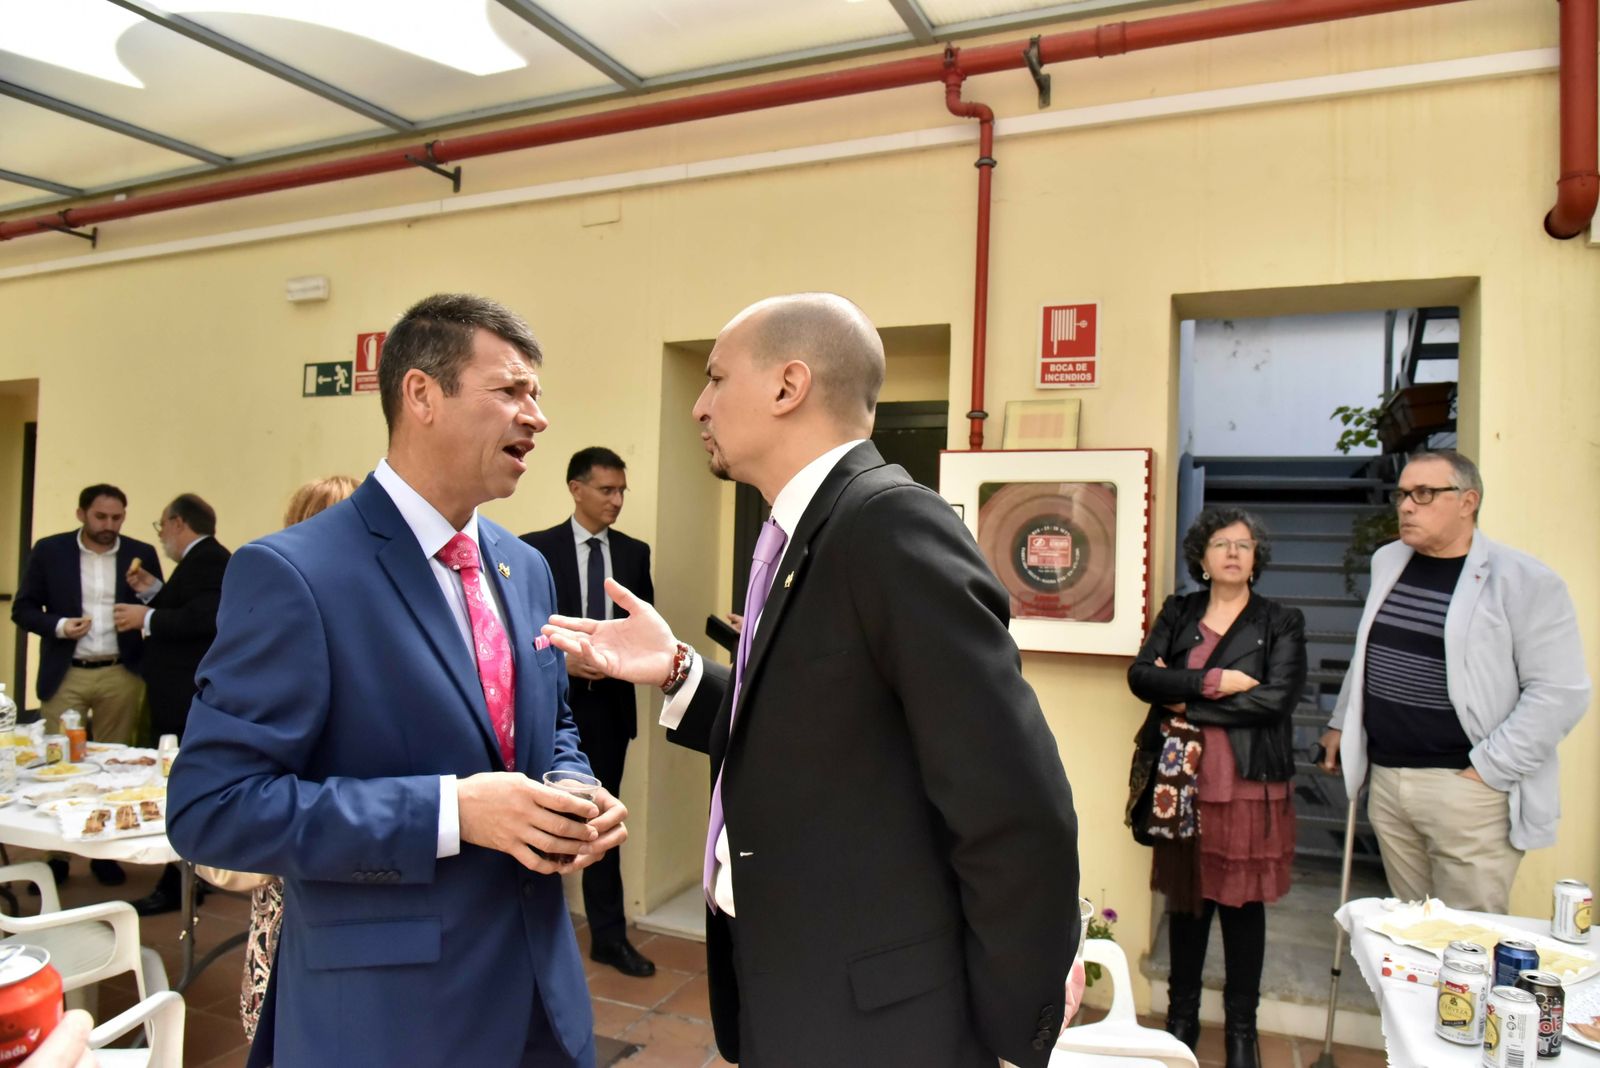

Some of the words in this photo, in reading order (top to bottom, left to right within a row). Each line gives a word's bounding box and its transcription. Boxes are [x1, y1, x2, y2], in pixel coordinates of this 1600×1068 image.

[1049, 362, 1074, 372] BOCA
[1075, 362, 1088, 371] DE
[1044, 372, 1092, 382] INCENDIOS
[1538, 1016, 1562, 1034] ola
